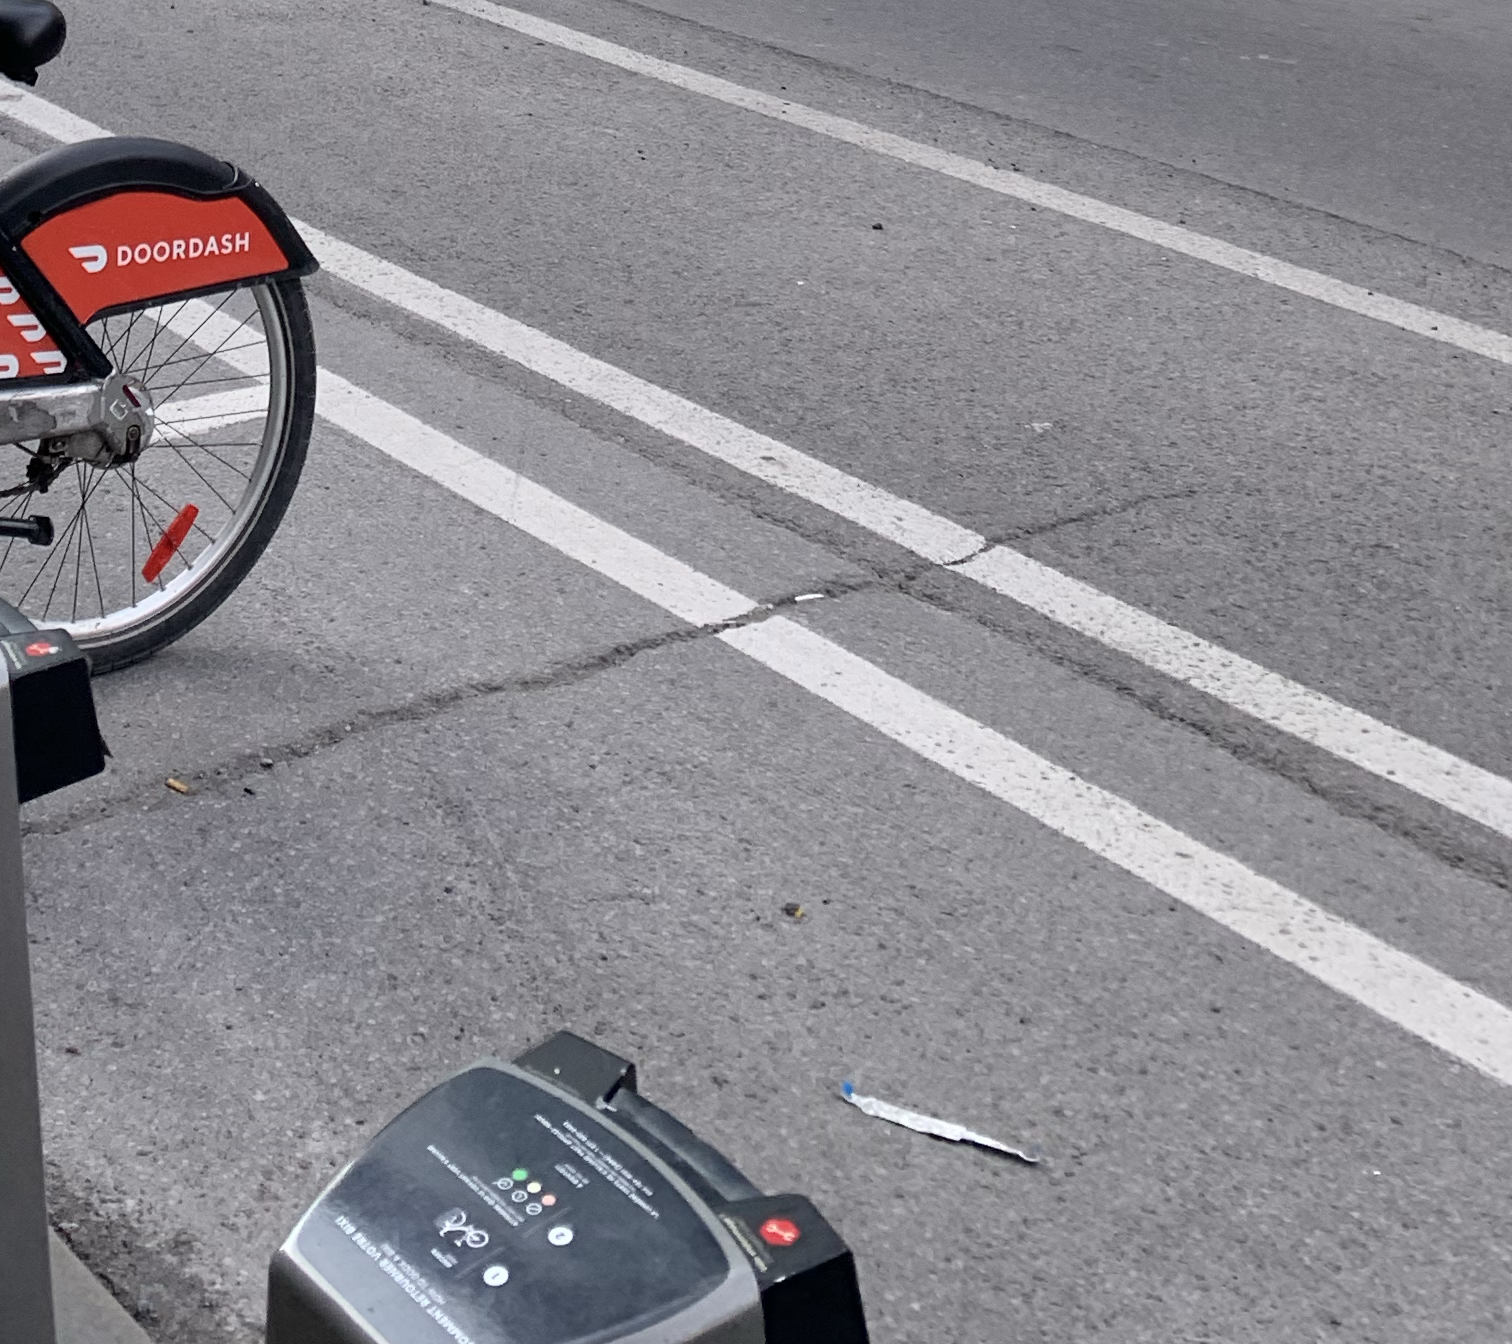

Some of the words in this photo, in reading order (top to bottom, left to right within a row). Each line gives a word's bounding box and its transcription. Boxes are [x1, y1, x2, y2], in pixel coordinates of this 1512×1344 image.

[116, 232, 250, 267] DOORDASH
[334, 1214, 356, 1236] BIXI
[350, 1231, 382, 1261] VOTRE
[377, 1257, 431, 1309] RETOURNER
